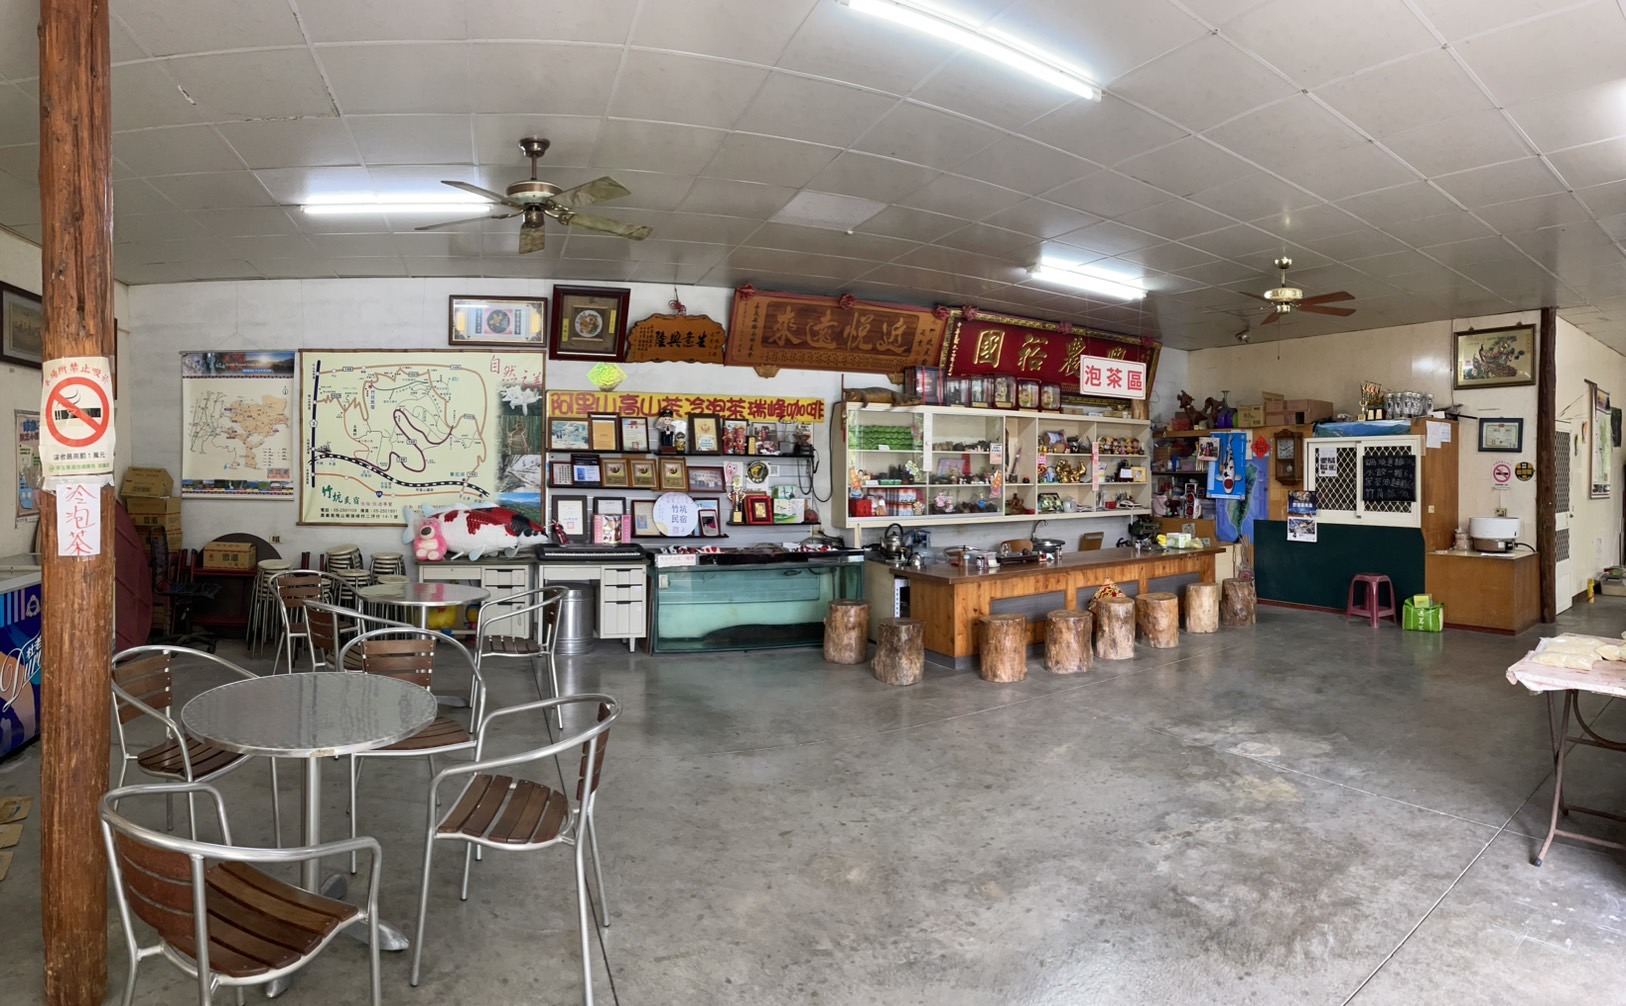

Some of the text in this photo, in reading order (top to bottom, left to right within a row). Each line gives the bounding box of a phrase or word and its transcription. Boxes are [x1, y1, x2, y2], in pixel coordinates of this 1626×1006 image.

[490, 355, 542, 387] 自然之美
[1084, 365, 1142, 391] 泡茶區
[322, 485, 360, 505] 竹坑民宿
[65, 485, 97, 556] 冷泡茶
[672, 504, 688, 514] 竹坑
[672, 514, 688, 524] 民宿
